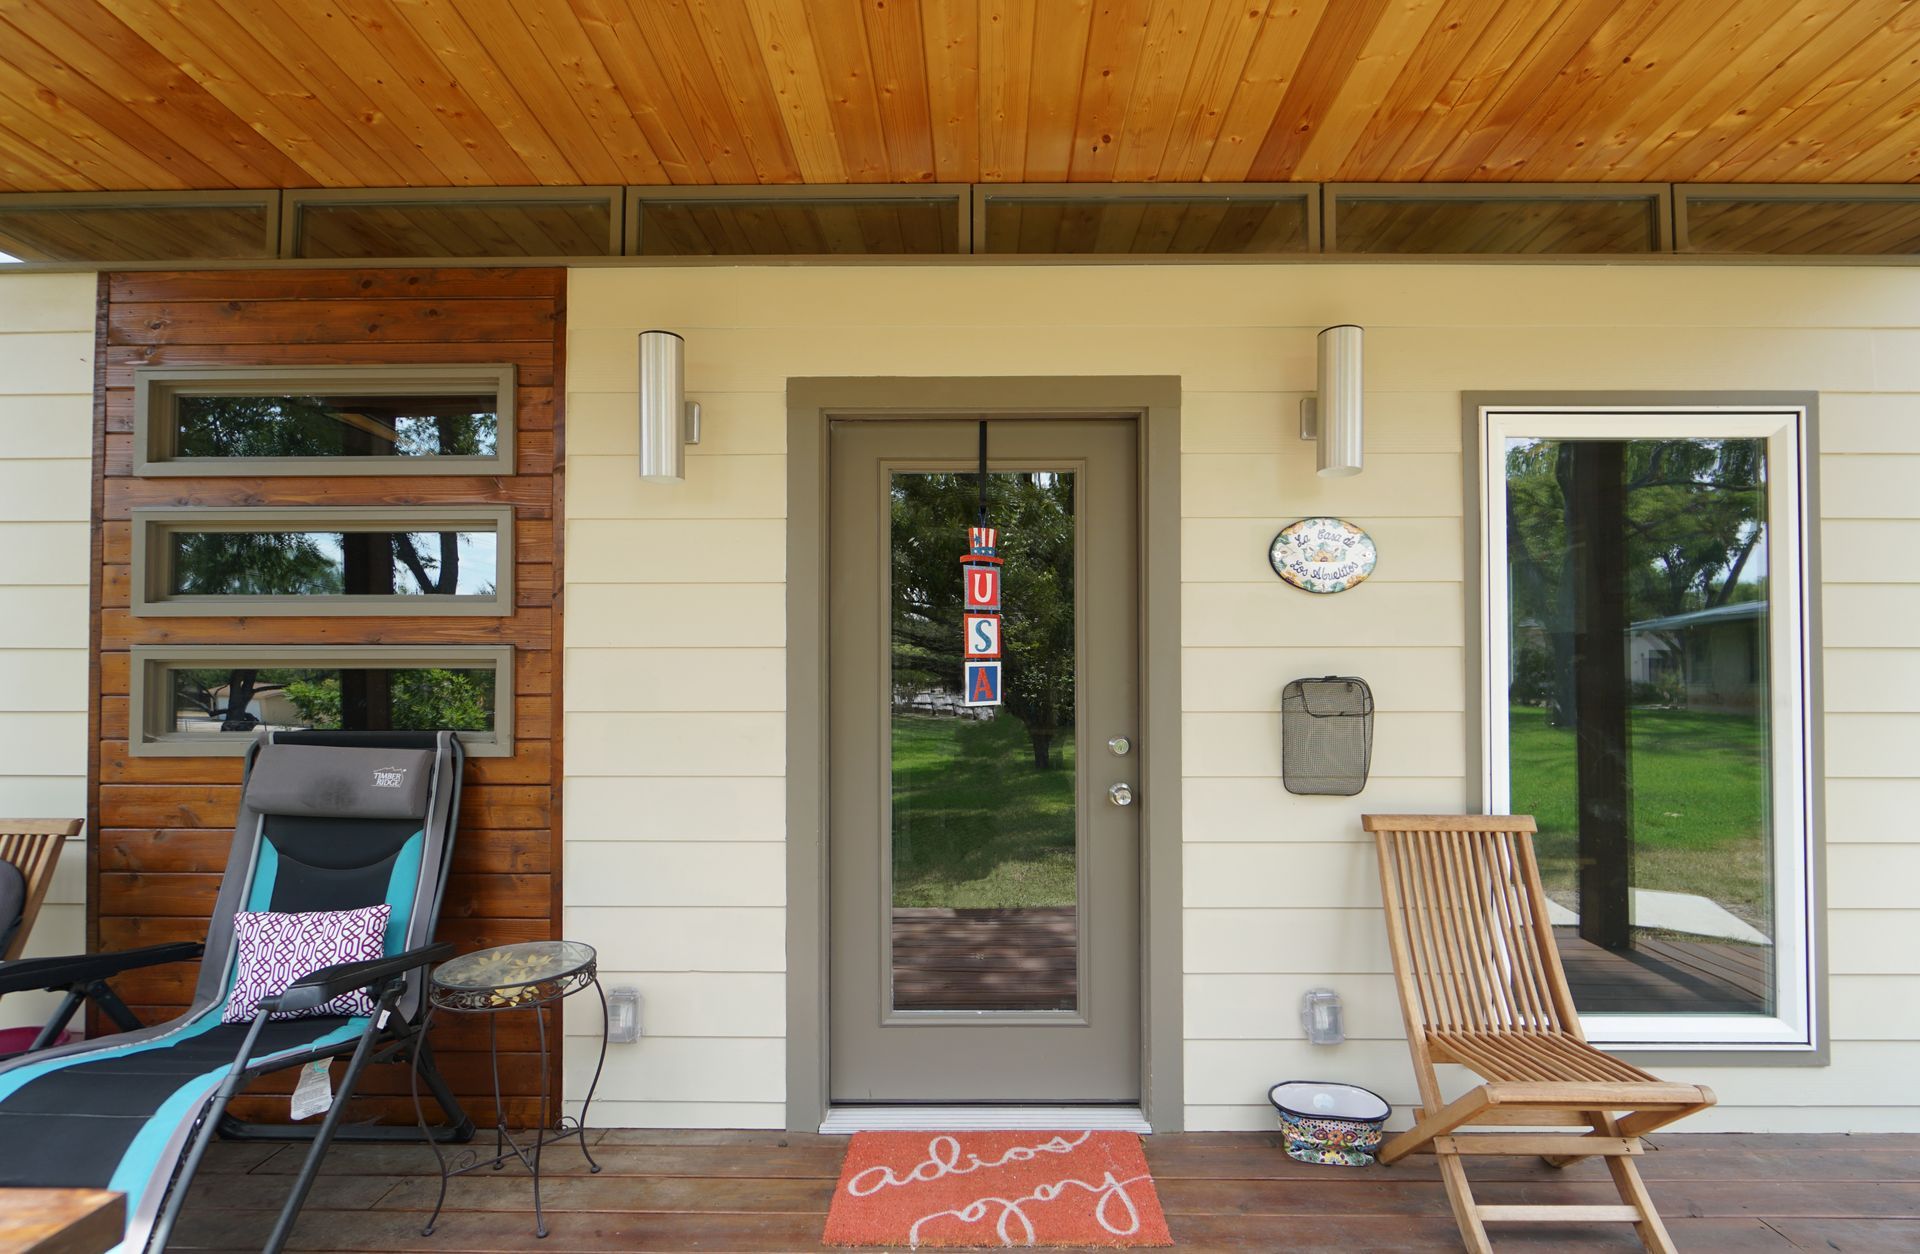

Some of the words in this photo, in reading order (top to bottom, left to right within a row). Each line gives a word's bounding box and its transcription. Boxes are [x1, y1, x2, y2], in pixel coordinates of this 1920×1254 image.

[1310, 561, 1358, 580] Abuelitos
[373, 772, 401, 780] TIMBER
[849, 1130, 1092, 1197] adios
